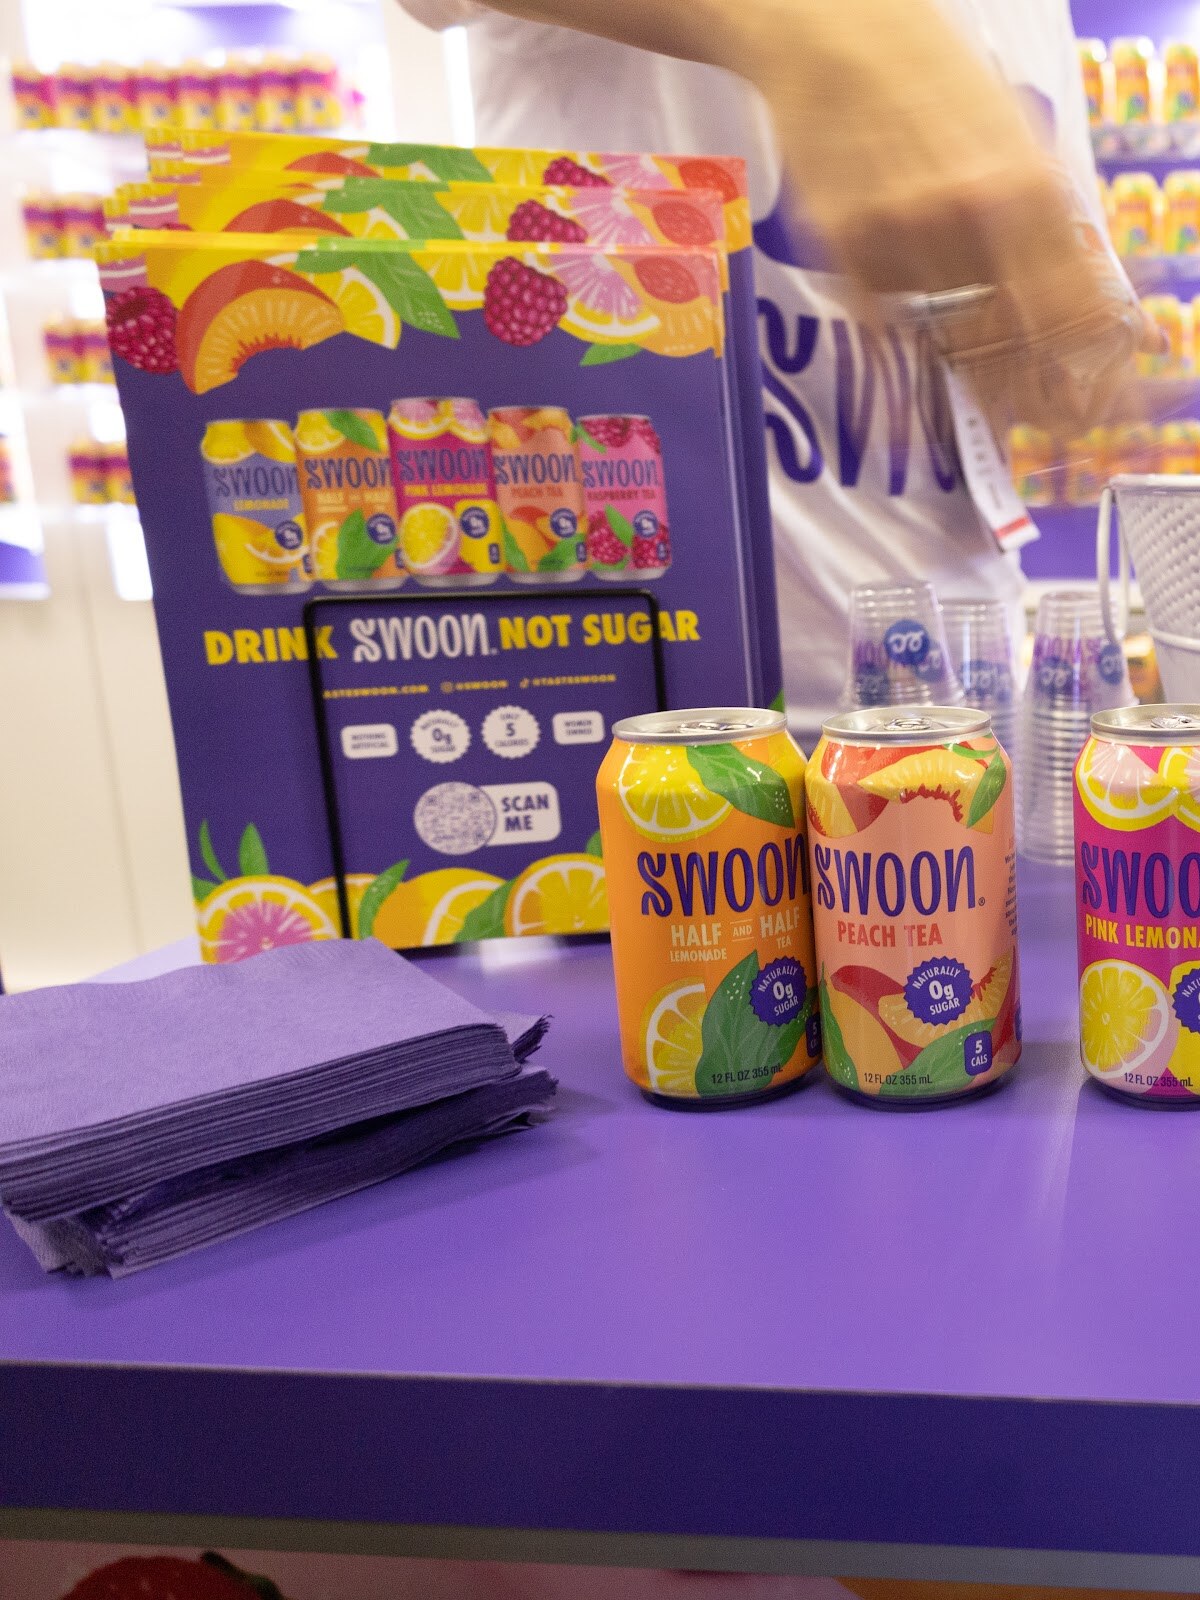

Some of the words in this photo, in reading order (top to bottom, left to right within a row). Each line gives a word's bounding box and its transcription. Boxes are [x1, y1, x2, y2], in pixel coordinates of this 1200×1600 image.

[397, 448, 487, 481] SWOON
[493, 454, 577, 485] SWOON
[582, 460, 657, 488] SWOON
[204, 625, 338, 665] DRINK
[350, 614, 489, 663] SWOON
[499, 615, 571, 649] NOT
[582, 611, 700, 646] SUGAR
[323, 684, 429, 698] ASTESWOON.COM
[506, 723, 516, 737] 5
[501, 794, 549, 812] SCAN
[504, 816, 533, 832] ME
[637, 833, 807, 917] SWOON
[815, 843, 976, 917] SWOON
[670, 923, 722, 947] HALF
[732, 925, 752, 937] AND
[760, 907, 800, 939] HALF
[838, 921, 895, 947] PEACH
[903, 923, 943, 947] TEA
[1085, 914, 1119, 944] PINK
[776, 934, 792, 950] TEA
[669, 947, 727, 963] LEMONADE
[757, 965, 798, 992] NATURALLY
[912, 965, 961, 990] NATURALLY
[772, 982, 793, 1000] 0g
[929, 980, 954, 1001] 0g
[773, 996, 799, 1017] SUGAR
[930, 998, 960, 1015] SUGAR
[975, 1040, 983, 1053] 5
[971, 1054, 988, 1067] CALS
[711, 1073, 723, 1085] 12
[724, 1072, 736, 1084] FL
[737, 1070, 750, 1083] OZ
[752, 1066, 769, 1081] 355
[771, 1063, 783, 1074] mL
[864, 1072, 873, 1083] 12
[874, 1073, 884, 1084] FL
[886, 1074, 898, 1085] OZ
[900, 1074, 917, 1085] 355
[918, 1073, 933, 1084] mL
[1124, 1072, 1134, 1083] 12
[1135, 1073, 1145, 1085] FL
[1146, 1075, 1159, 1086] OZ
[1160, 1076, 1178, 1088] 355
[1179, 1076, 1193, 1087] mL
